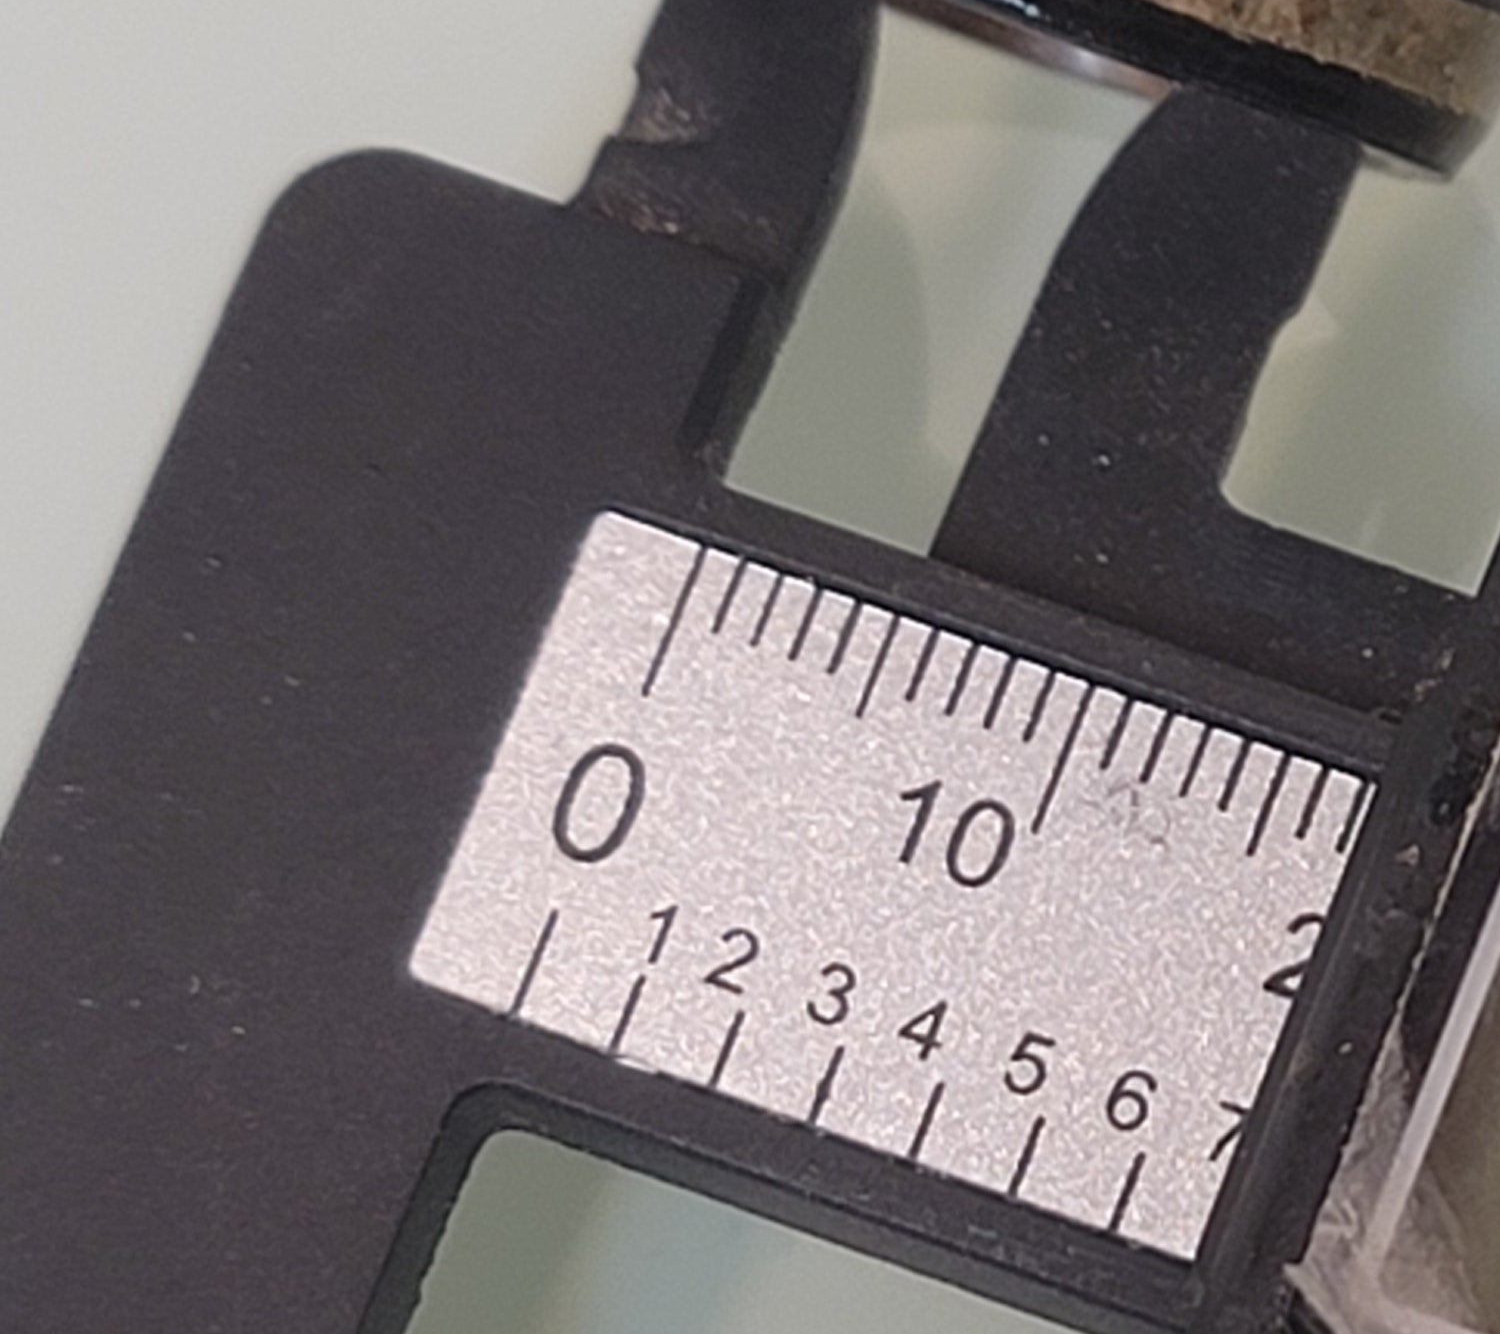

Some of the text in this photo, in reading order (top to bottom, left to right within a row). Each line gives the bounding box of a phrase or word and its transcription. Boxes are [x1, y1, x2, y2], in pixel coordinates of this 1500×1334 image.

[551, 743, 647, 863] 0
[899, 780, 1016, 887] 10
[648, 903, 1253, 1162] 1 2 3 4 5 6 7
